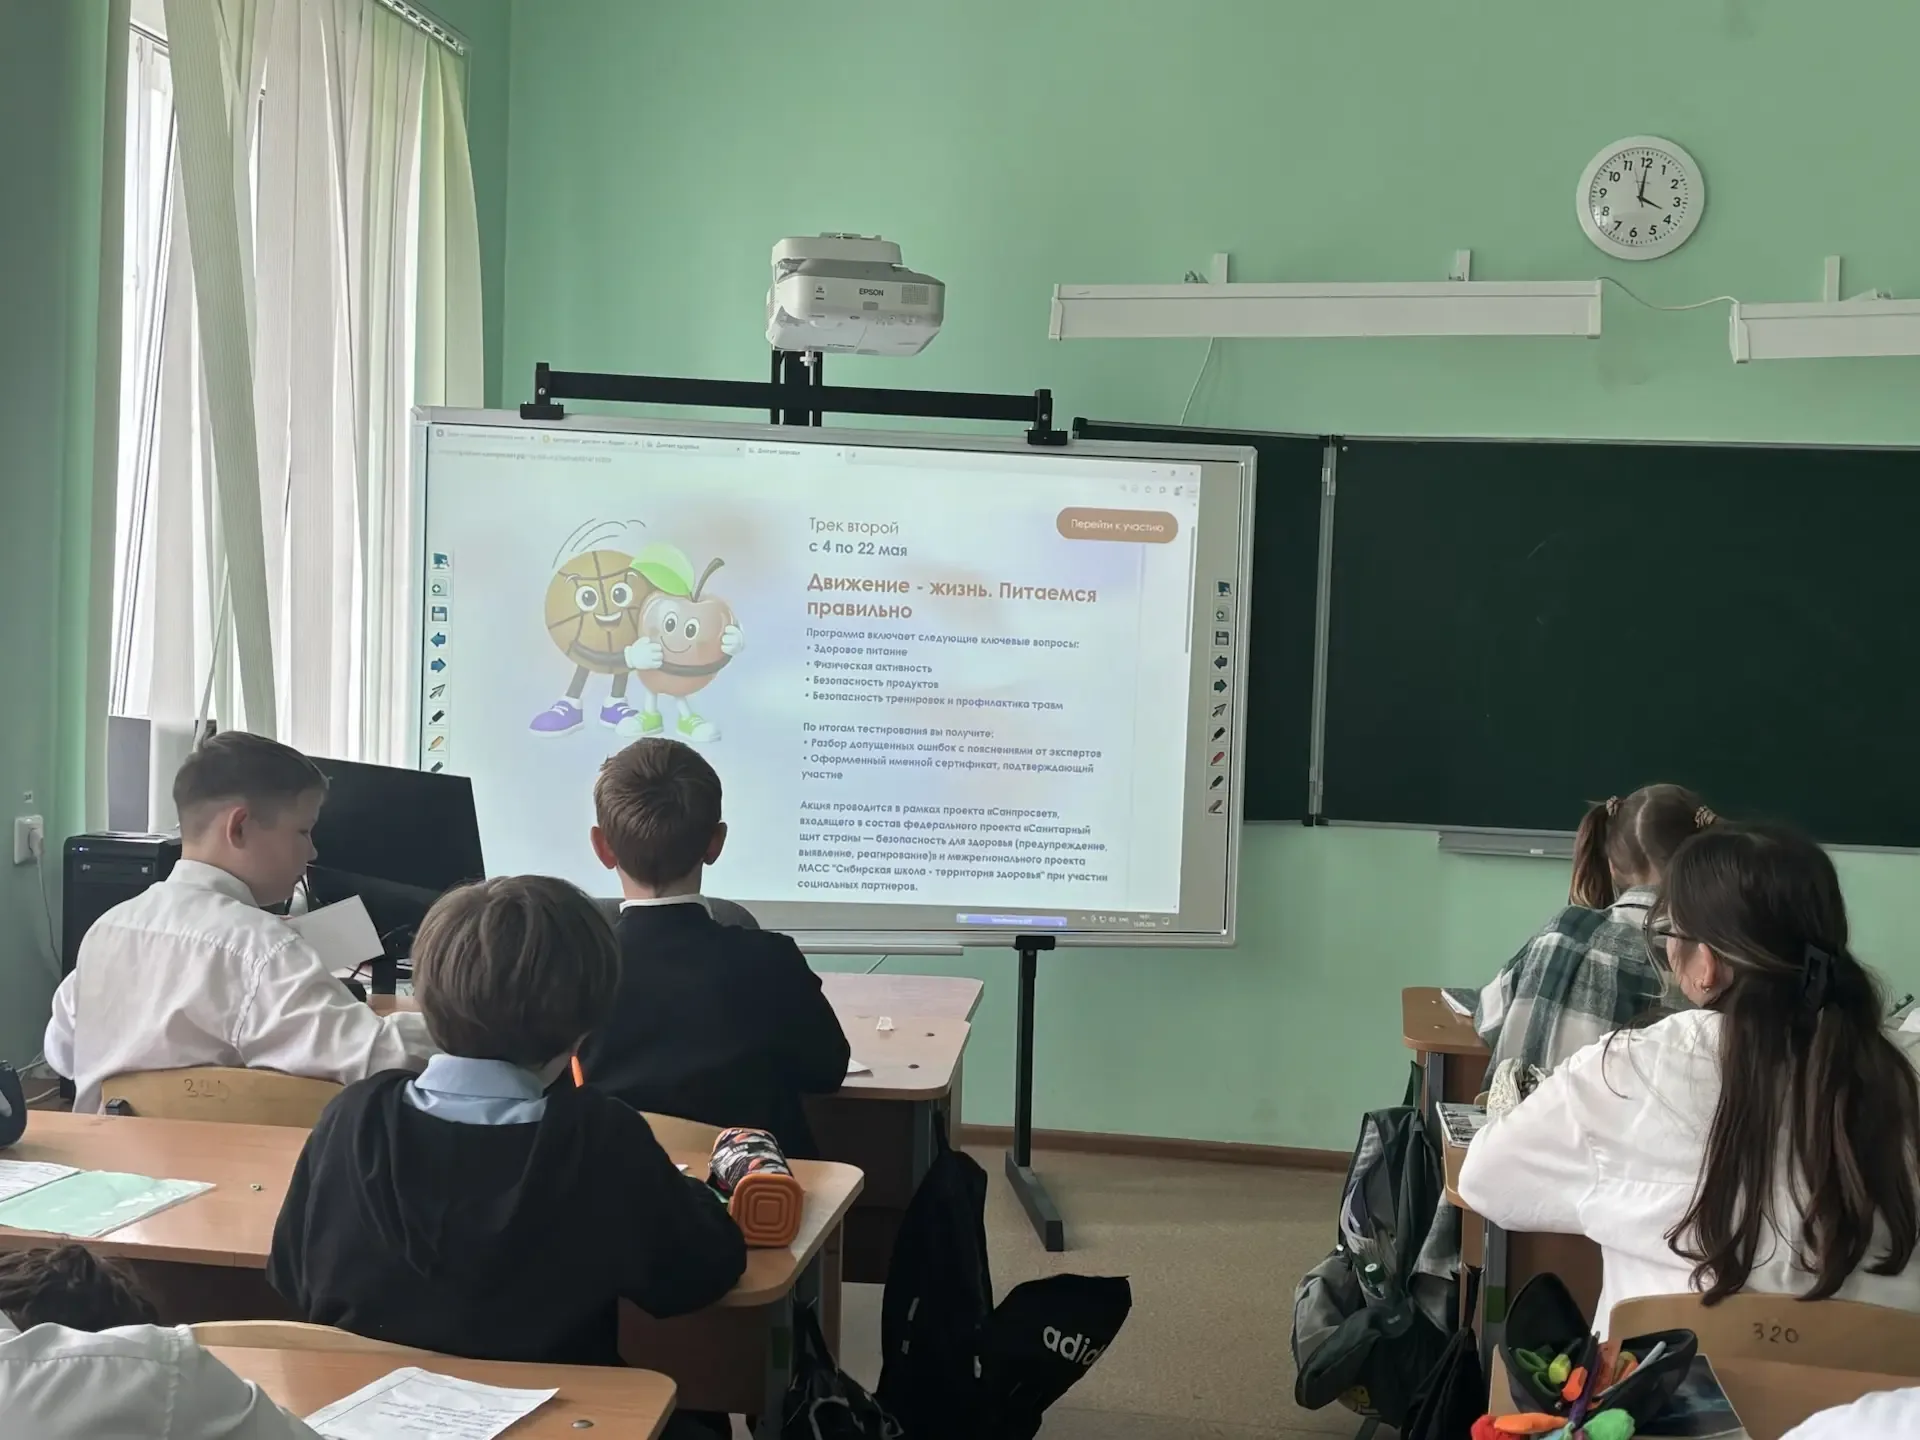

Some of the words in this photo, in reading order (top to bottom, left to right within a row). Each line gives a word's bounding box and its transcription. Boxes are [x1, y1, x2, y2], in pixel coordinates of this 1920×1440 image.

[1624, 160, 1633, 171] 11
[1641, 157, 1653, 168] 12
[1609, 171, 1621, 182] 10
[1661, 165, 1667, 175] 1
[1670, 179, 1679, 189] 2
[1599, 187, 1607, 198] 9
[1672, 196, 1681, 207] 3
[1602, 206, 1610, 216] 8
[1614, 220, 1622, 231] 7
[1663, 214, 1672, 224] 4
[1629, 227, 1638, 237] 6
[1648, 225, 1657, 235] 5
[859, 287, 884, 296] EPSON
[810, 517, 844, 534] Трек
[848, 521, 898, 537] второй
[1071, 518, 1113, 531] Перейти
[1123, 523, 1164, 532] участию
[809, 542, 818, 552] с
[823, 540, 831, 552] 4
[836, 543, 853, 555] по
[858, 542, 875, 556] 22
[878, 546, 907, 557] мая
[807, 573, 910, 596] Движение
[930, 582, 992, 598] жизнь.
[1000, 583, 1096, 603] Питаемся
[808, 601, 912, 623] правильно
[807, 628, 865, 641] Программа
[867, 631, 916, 641] включает
[918, 634, 978, 645] следующие
[981, 636, 1030, 646] ключевые
[1033, 638, 1079, 649] вопросы:
[814, 644, 863, 657] Здоровое
[866, 646, 908, 657] питание
[814, 660, 873, 671] Физическая
[875, 663, 932, 673] активность
[814, 676, 884, 687] Безопасность
[886, 680, 938, 691] продуктов
[813, 691, 883, 702] Безопасность
[885, 695, 945, 706] тренировок
[956, 697, 1029, 709] профилактика
[1032, 701, 1063, 711] травм
[804, 722, 816, 732] По
[819, 723, 855, 733] итогам
[857, 725, 927, 738] тестирования
[930, 728, 943, 736] вы
[812, 738, 847, 750] Разбор
[849, 741, 914, 753] допущенных
[917, 741, 956, 752] ошибок
[968, 745, 1033, 755] пояснениями
[1049, 748, 1101, 760] экспертов
[811, 754, 886, 767] Оформленный
[889, 755, 933, 768] именной
[1003, 761, 1093, 775] подтверждающий
[802, 770, 843, 781] участие
[800, 800, 831, 810] Акция
[833, 803, 892, 814] проводится
[895, 804, 900, 812] в
[903, 805, 940, 817] рамках
[944, 806, 985, 817] проекта
[800, 817, 855, 827] входящего
[857, 819, 863, 827] в
[865, 819, 901, 828] состав
[903, 820, 977, 832] федерального
[980, 823, 1021, 834] проекта
[800, 833, 820, 842] щит
[823, 833, 861, 844] страны
[876, 834, 946, 845] безопасность
[948, 836, 965, 846] для
[968, 838, 1013, 848] здоровья
[947, 854, 1042, 865] межрегионального
[1044, 856, 1085, 867] проекта
[798, 862, 830, 872] МАСС
[894, 866, 926, 876] школа
[935, 869, 994, 880] территория
[1047, 872, 1065, 882] при
[1068, 873, 1107, 883] участии
[798, 880, 858, 889] социальных
[1753, 1322, 1799, 1344] 320
